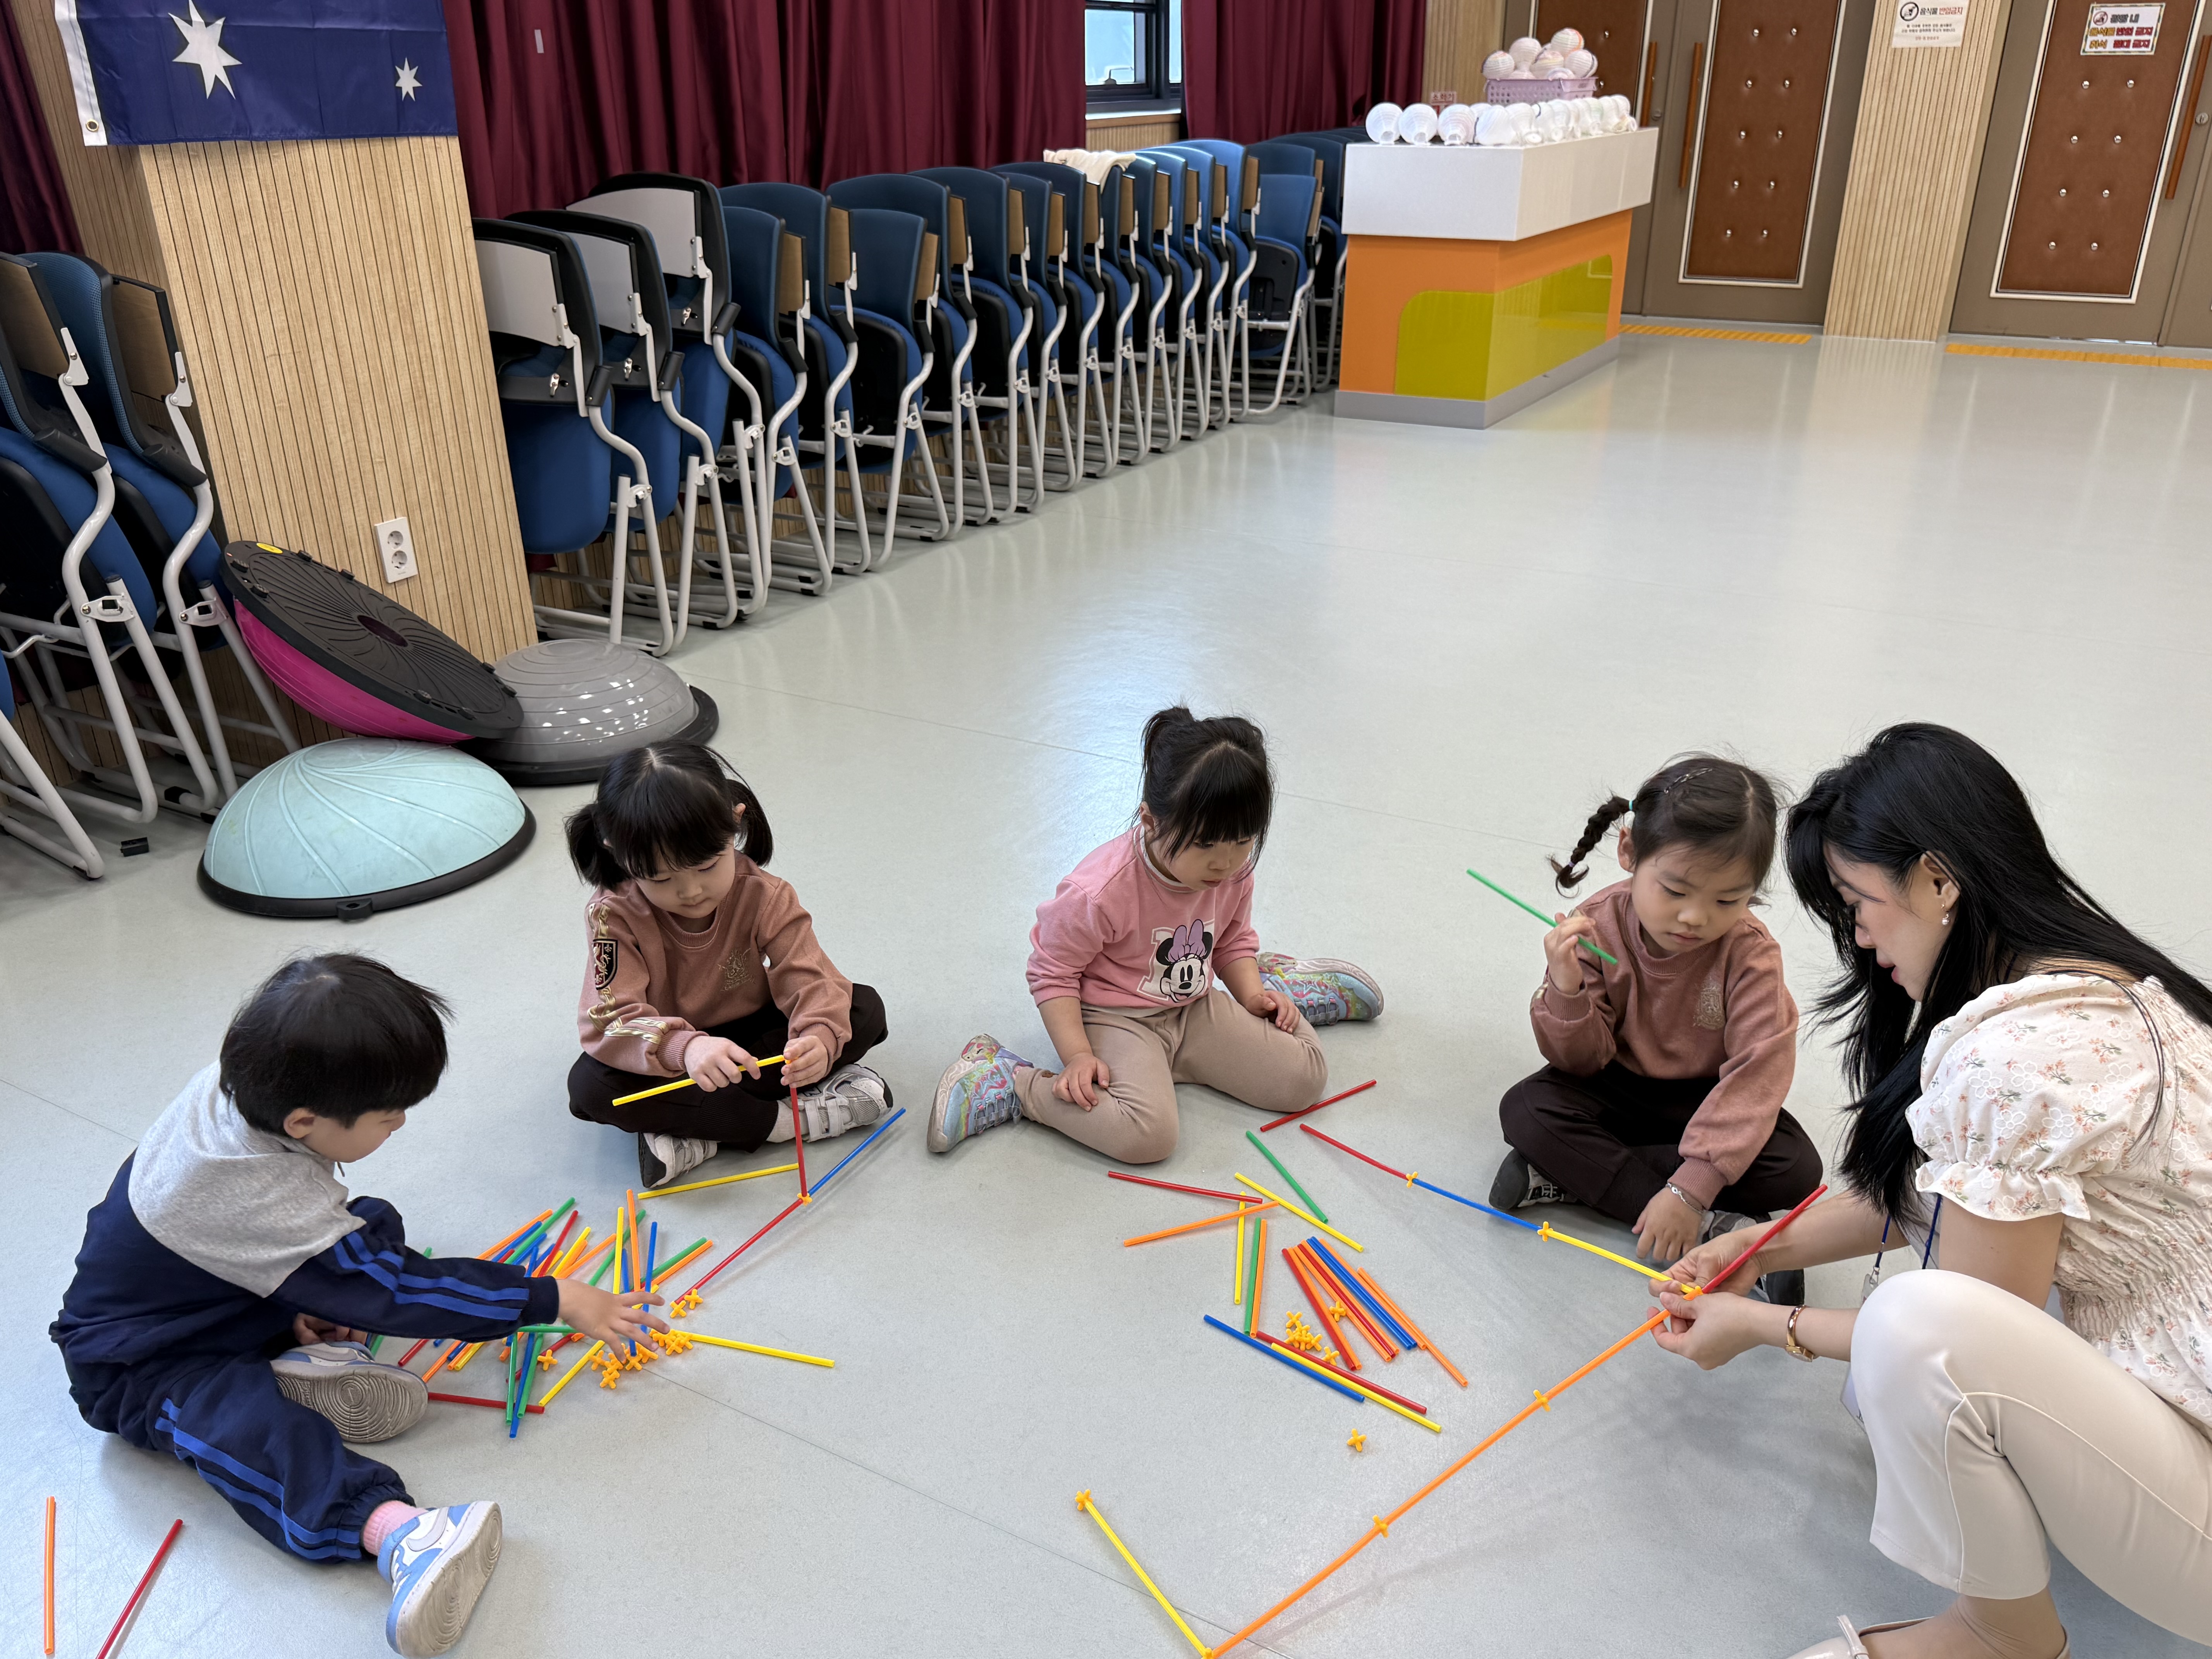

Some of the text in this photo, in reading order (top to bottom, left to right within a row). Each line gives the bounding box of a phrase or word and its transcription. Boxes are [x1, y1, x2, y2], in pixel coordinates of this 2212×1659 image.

[1939, 7, 1963, 15] 반입금지
[2130, 14, 2139, 23] 내
[2090, 27, 2153, 36] 음식물 반입 금지
[2132, 40, 2150, 48] 금지
